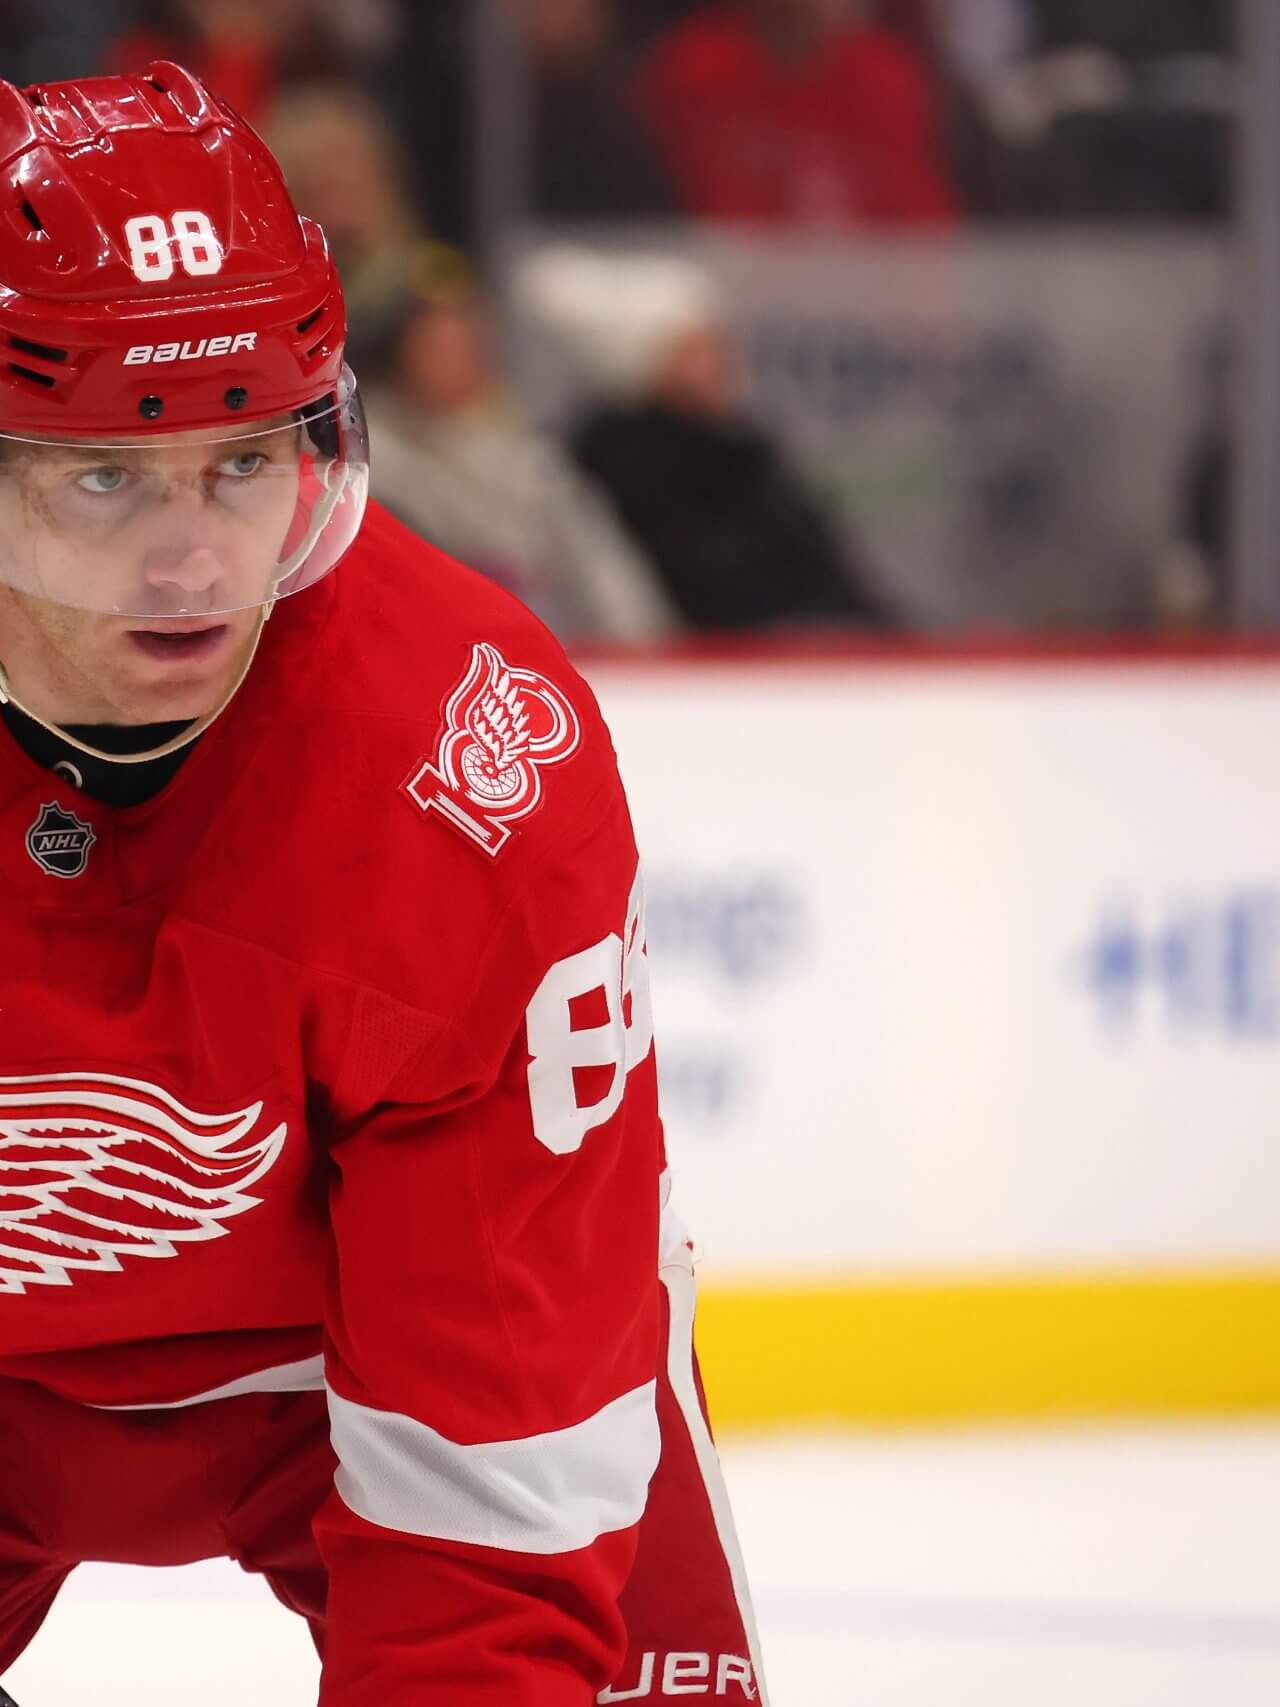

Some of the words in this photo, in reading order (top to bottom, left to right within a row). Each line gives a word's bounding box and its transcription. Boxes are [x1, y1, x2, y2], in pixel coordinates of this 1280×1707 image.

[124, 210, 223, 283] 88
[122, 331, 258, 366] BAUER
[38, 834, 82, 851] NHL
